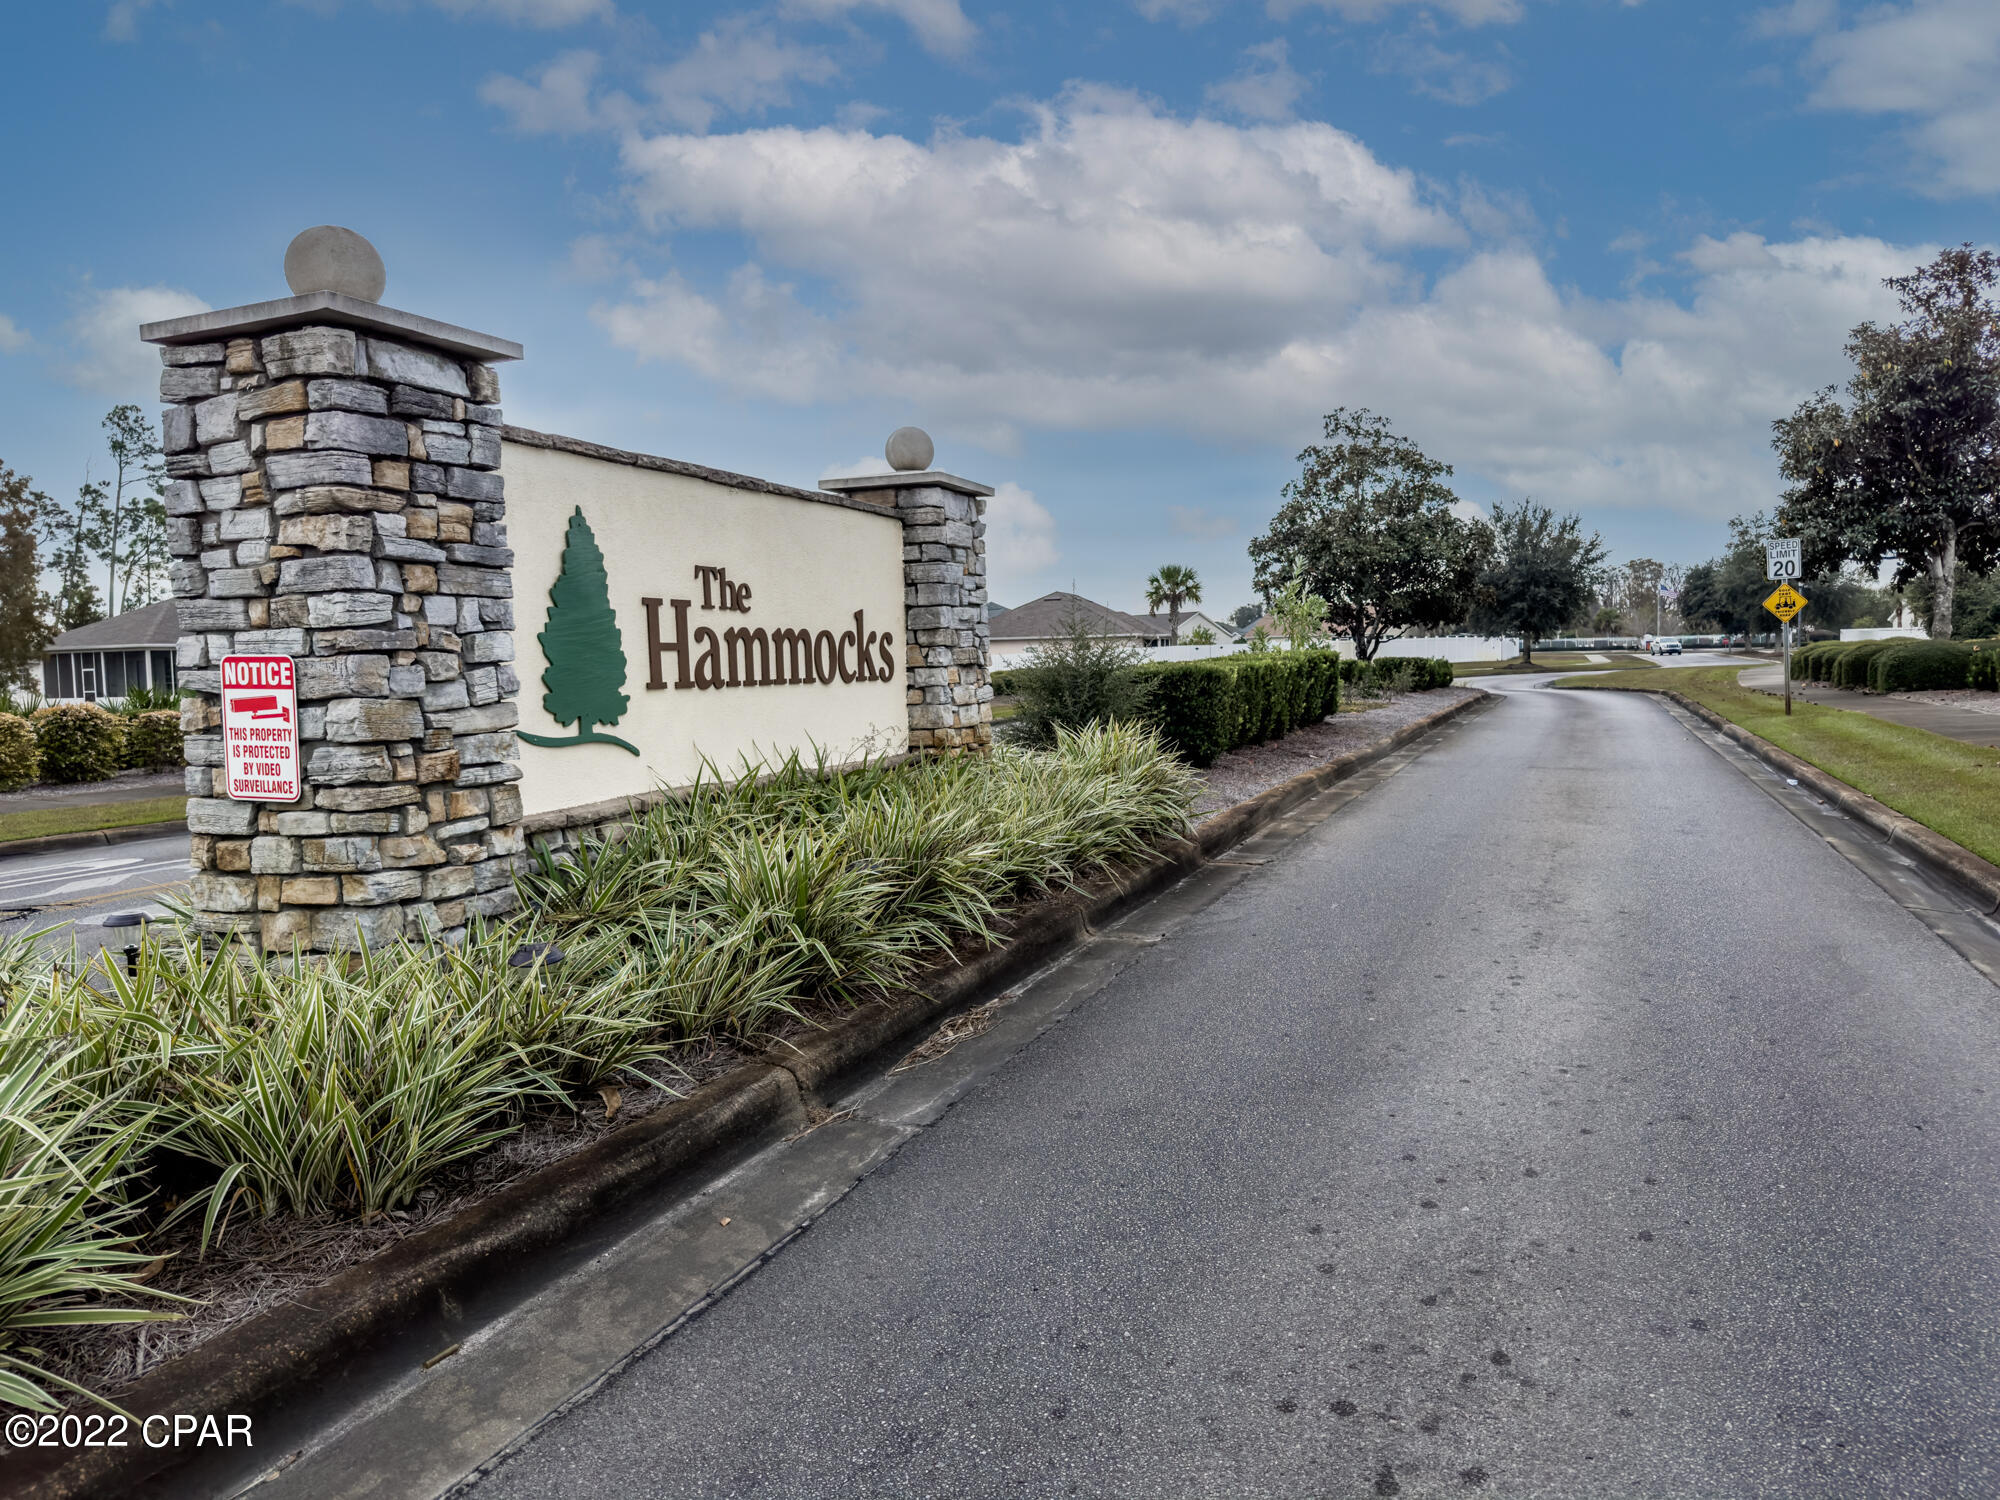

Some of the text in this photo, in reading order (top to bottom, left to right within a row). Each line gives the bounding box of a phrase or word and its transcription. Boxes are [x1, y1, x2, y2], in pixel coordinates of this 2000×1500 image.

[1769, 541, 1797, 550] SPEED
[1770, 549, 1797, 559] LIMIT
[1773, 560, 1795, 577] 20
[694, 564, 752, 613] The
[641, 597, 895, 690] Hammocks
[224, 661, 291, 686] NOTICE
[229, 727, 292, 742] THIS PROPERTY
[233, 745, 290, 759] IS PROTECTED
[244, 763, 281, 776] BY VIDEO
[234, 779, 293, 794] SURVEILLANCE
